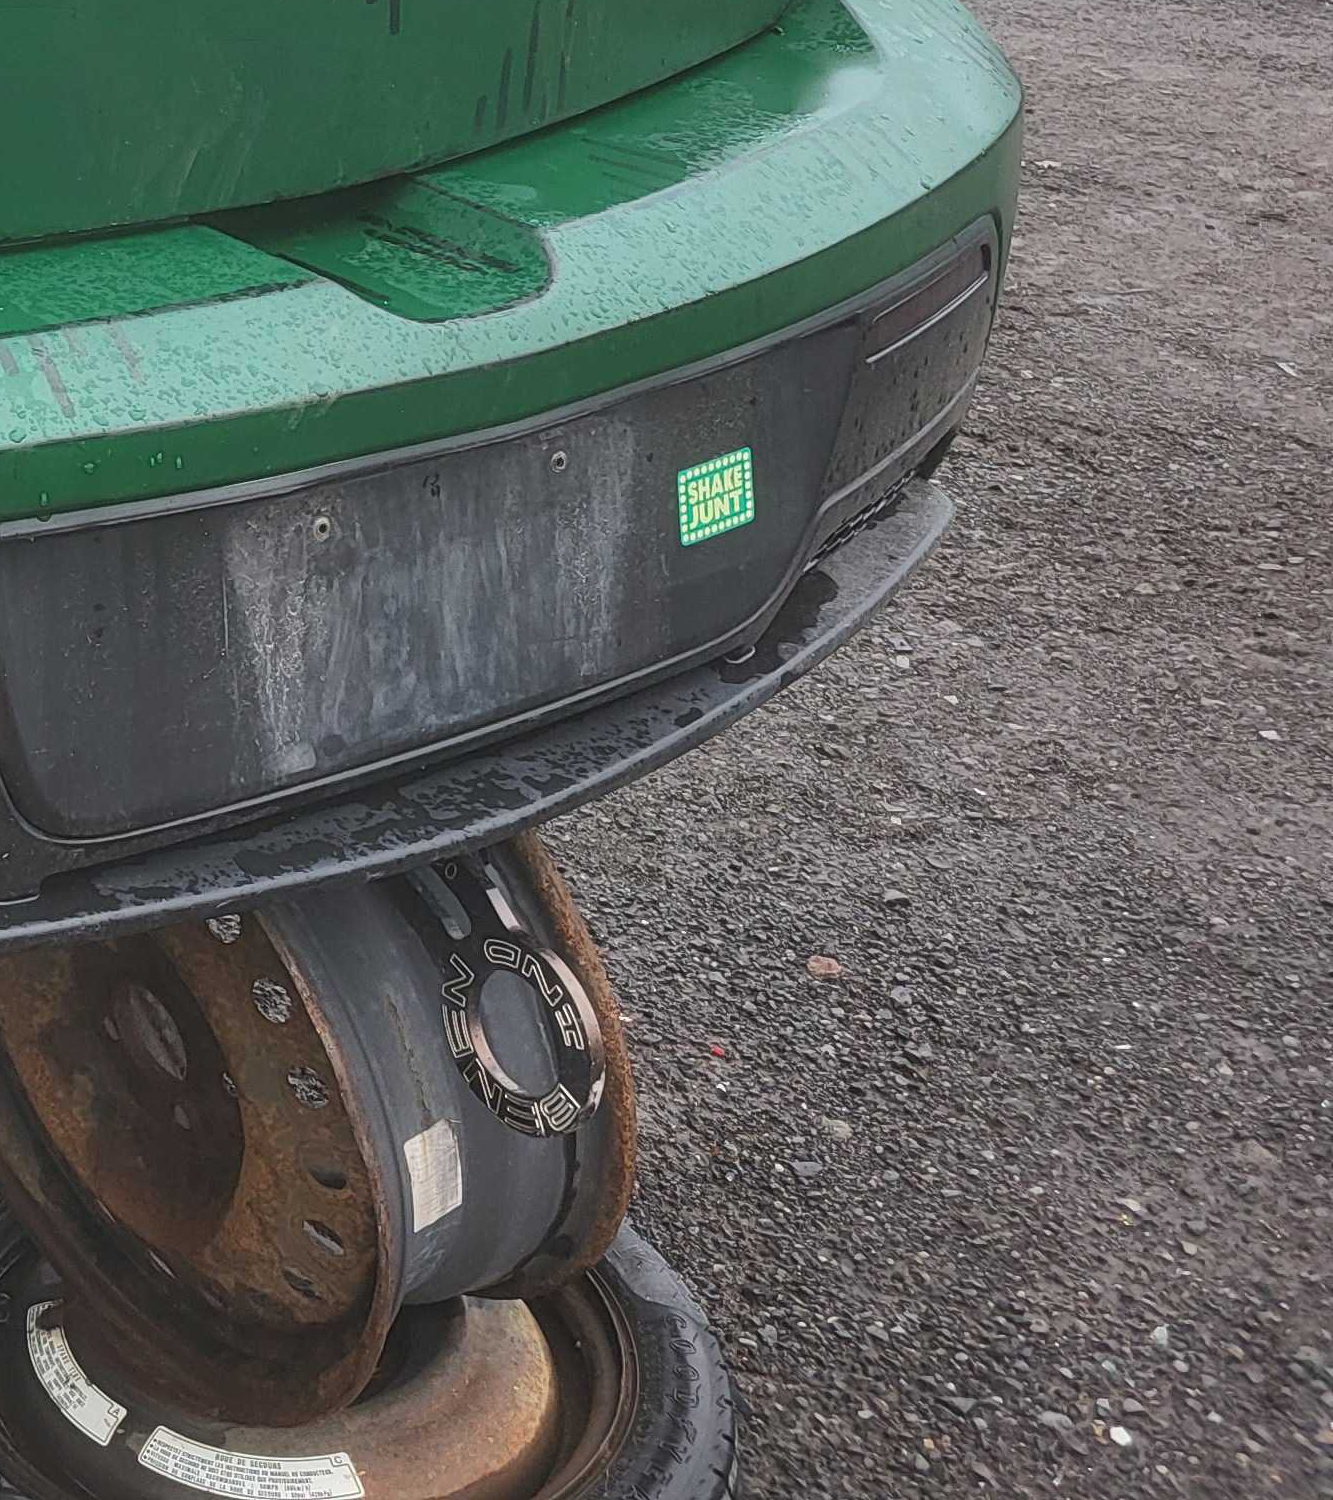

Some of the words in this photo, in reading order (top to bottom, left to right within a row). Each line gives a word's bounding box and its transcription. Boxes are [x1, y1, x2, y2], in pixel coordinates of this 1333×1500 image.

[688, 464, 742, 504] SHAKE
[689, 489, 742, 530] JUNT
[334, 1456, 342, 1464] C
